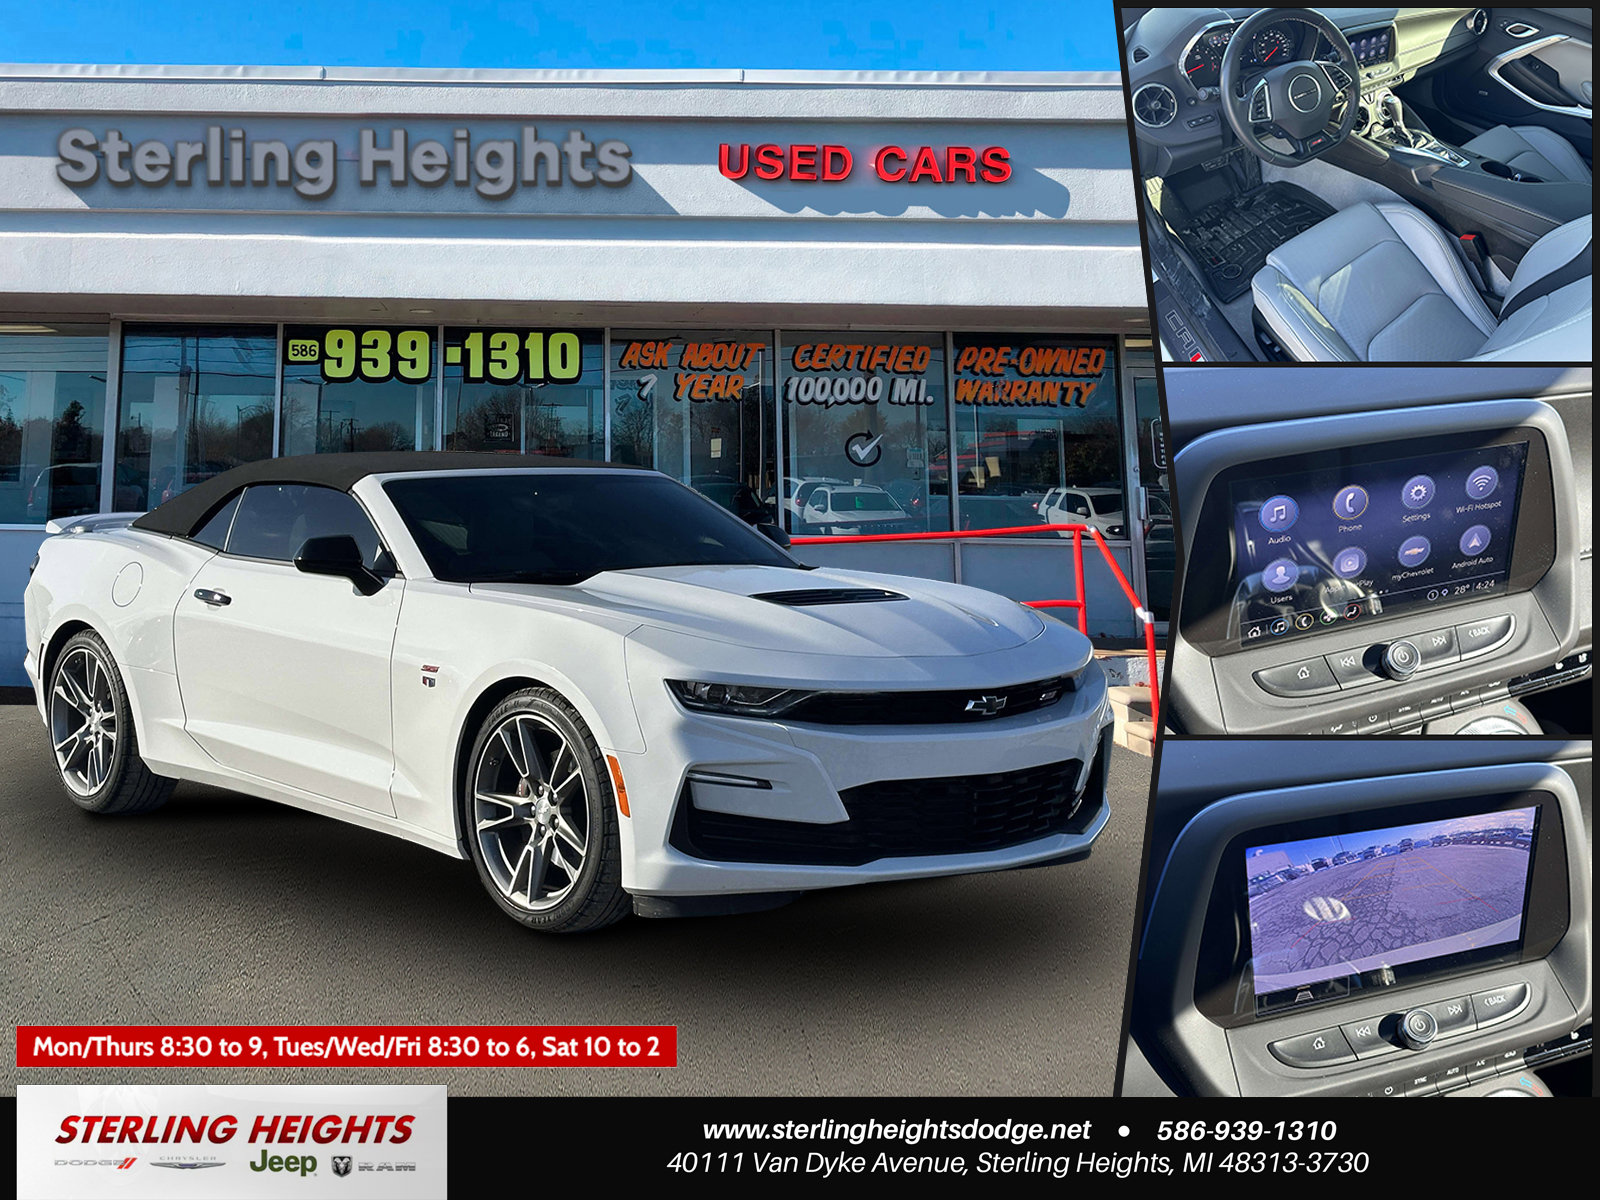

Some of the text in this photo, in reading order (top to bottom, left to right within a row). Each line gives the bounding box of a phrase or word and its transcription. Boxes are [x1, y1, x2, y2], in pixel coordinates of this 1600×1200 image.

[56, 126, 632, 199] Sterling Heights
[718, 143, 1012, 183] USED CARS
[291, 344, 317, 357] 586
[620, 341, 766, 371] ASK ABOUT
[793, 343, 931, 374] CERTIFIED
[955, 346, 1107, 377] PRE-OWNED
[674, 372, 745, 401] YEAR
[785, 376, 934, 409] 100,000 MI.
[955, 378, 1097, 407] WARRANTY
[1456, 501, 1502, 514] Wi-Fi Hotspot
[1402, 513, 1431, 523] Settings
[1338, 524, 1363, 533] Phone
[1268, 535, 1292, 545] Audio
[1451, 556, 1494, 570] Android Auto
[1391, 567, 1434, 581] myChevrolet
[1475, 580, 1495, 590] 4:24
[1270, 594, 1293, 604] Users
